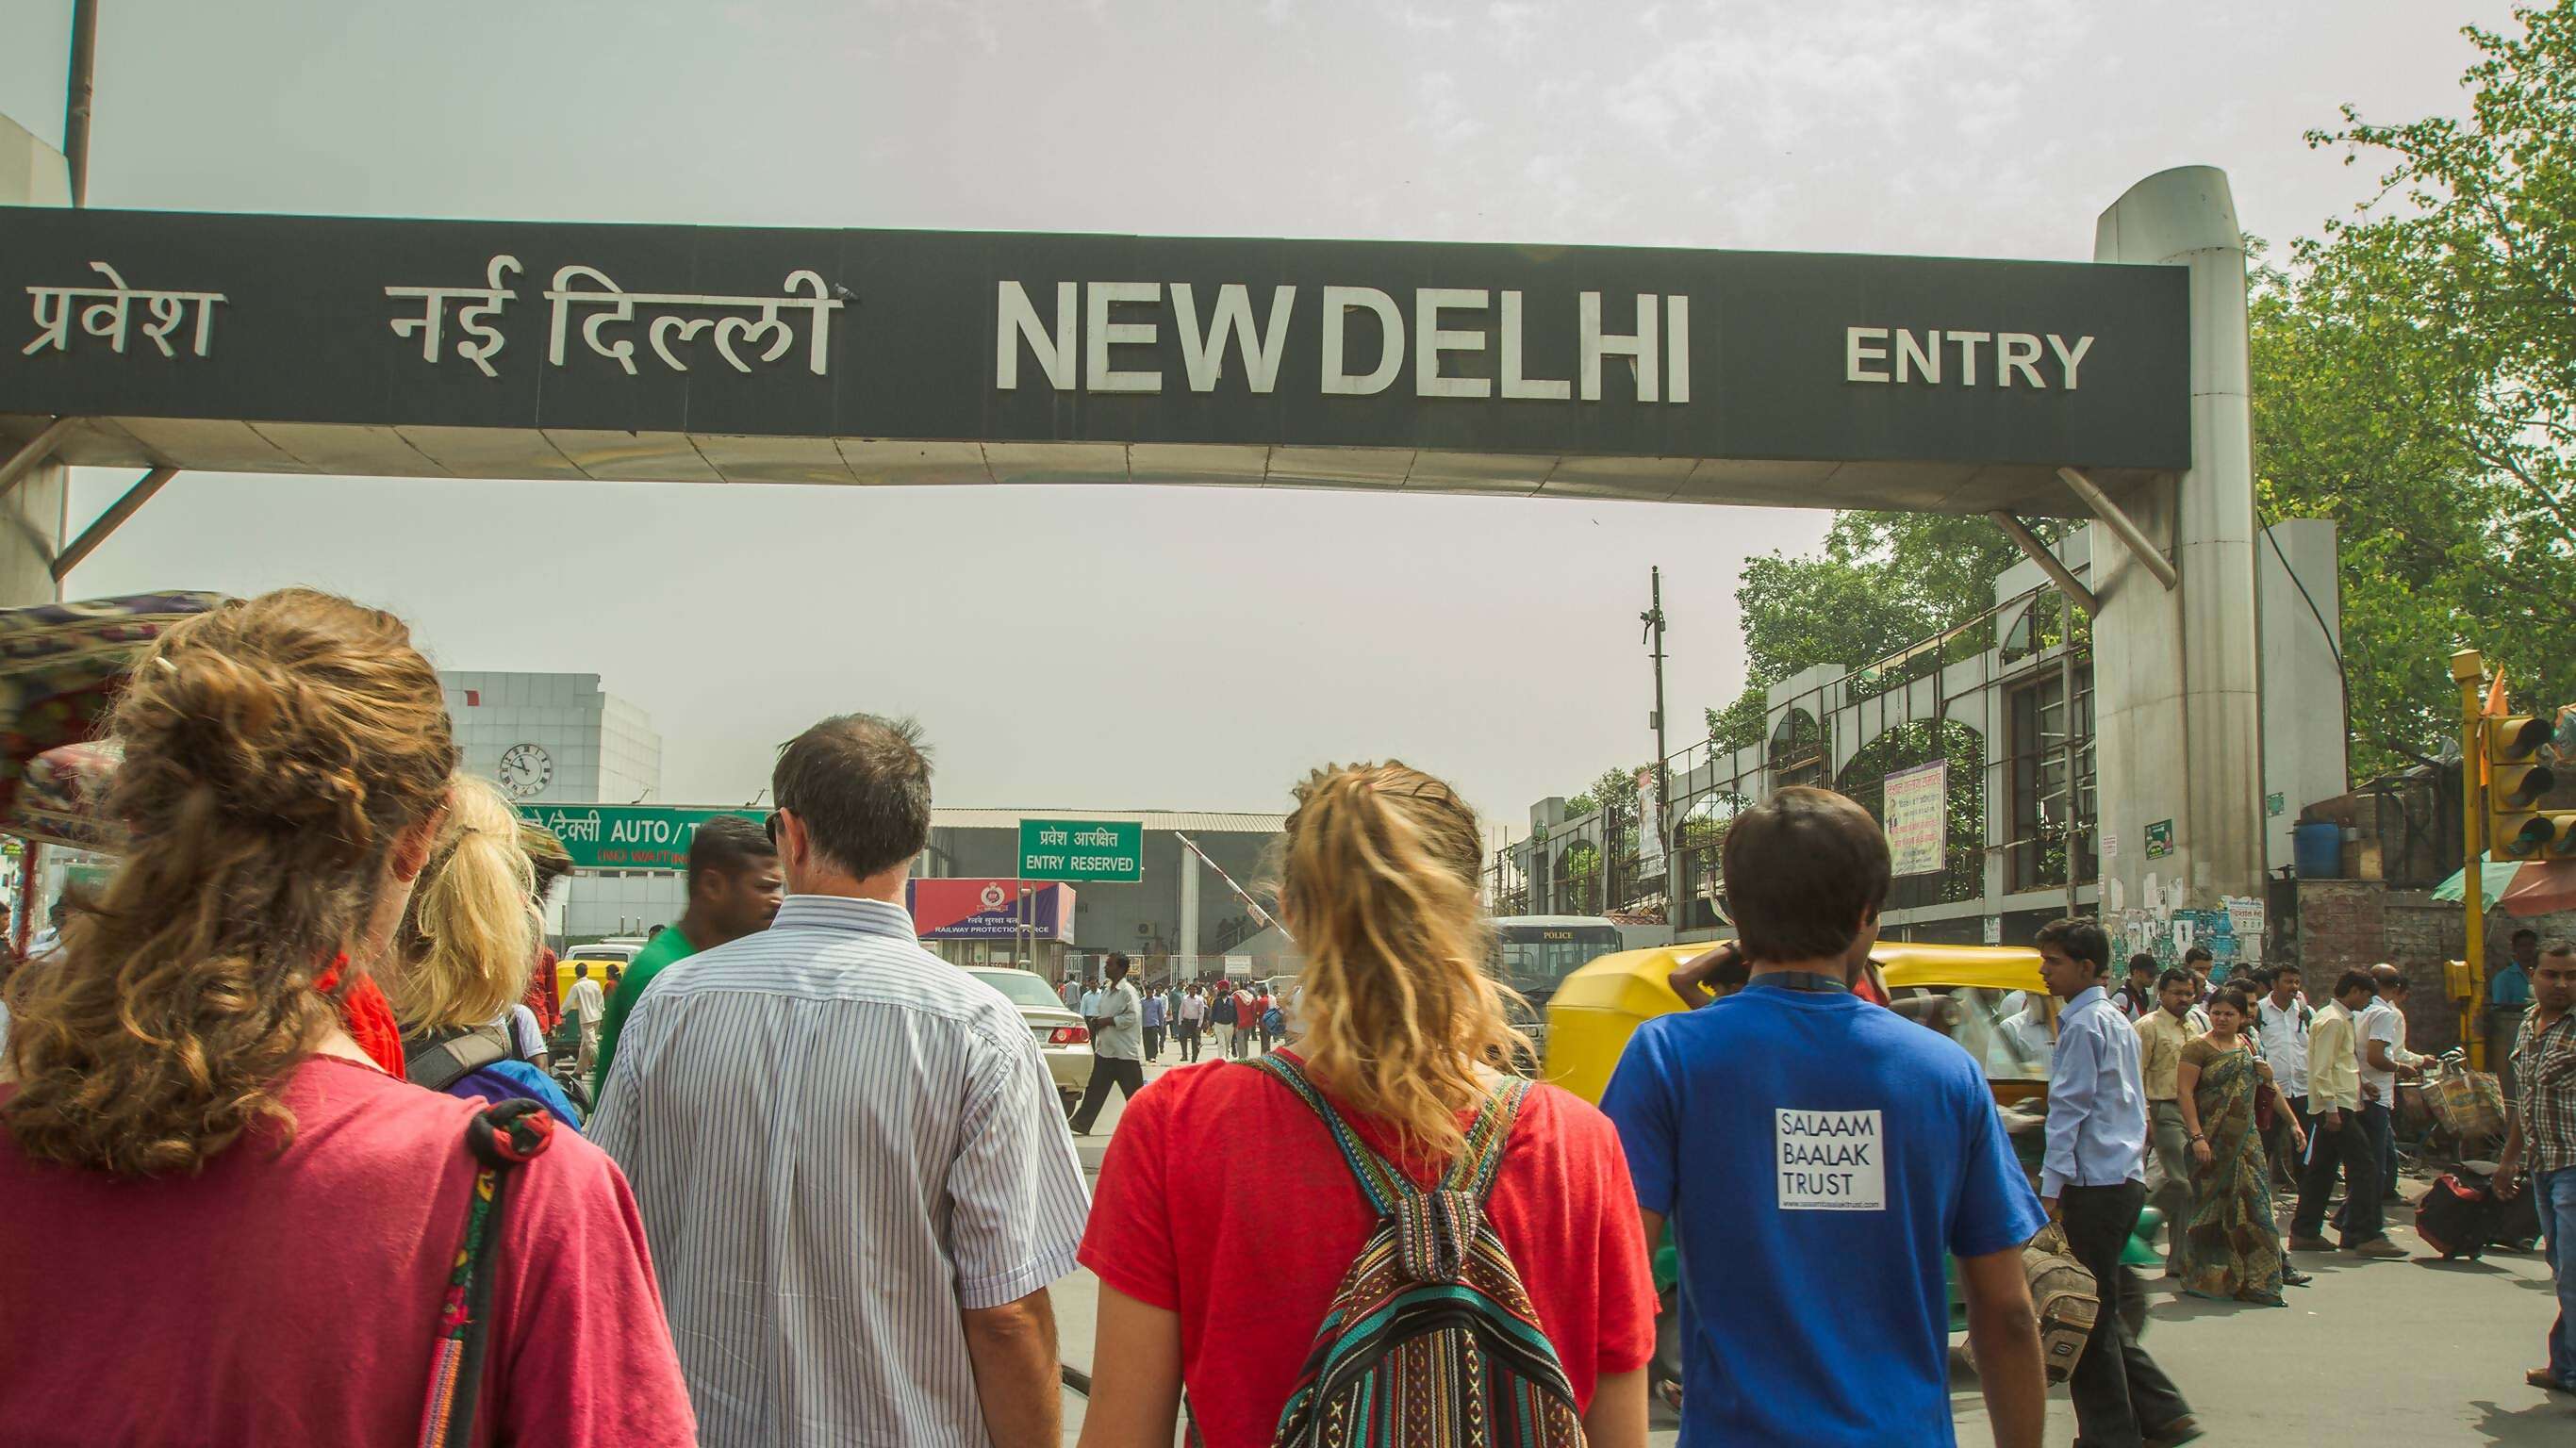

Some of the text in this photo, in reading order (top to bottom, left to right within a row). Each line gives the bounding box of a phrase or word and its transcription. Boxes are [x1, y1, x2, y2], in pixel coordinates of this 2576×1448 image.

[23, 260, 230, 357] प्रवेश
[385, 255, 845, 377] नई दिल्ली
[996, 280, 1690, 403] NEW DELHI
[1846, 326, 2095, 390] ENTRY
[1039, 826, 1119, 847] प्रवेश आरक्षित
[1026, 854, 1133, 872] ENTRY RESERVED
[1544, 931, 1574, 940] POLICE
[1781, 1112, 1874, 1137] SALAAM
[1783, 1142, 1871, 1166] BAALAK
[1782, 1172, 1854, 1195] TRUST
